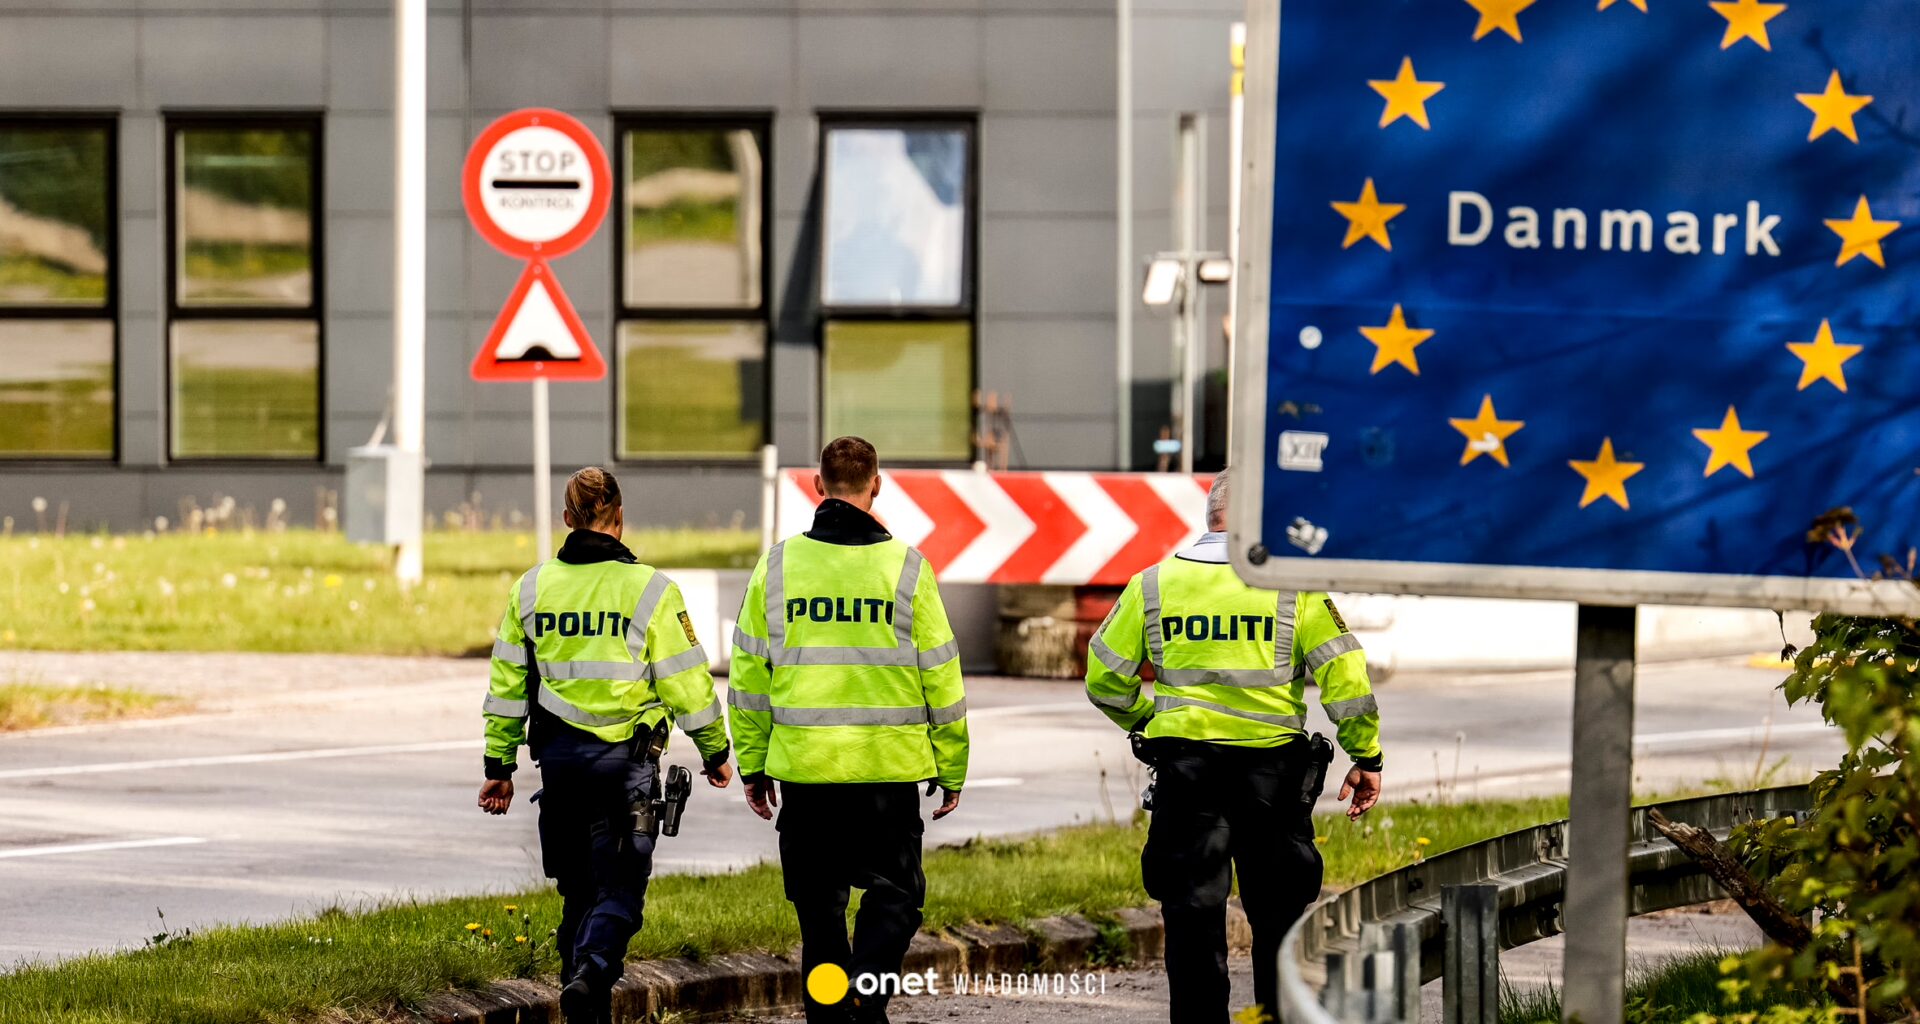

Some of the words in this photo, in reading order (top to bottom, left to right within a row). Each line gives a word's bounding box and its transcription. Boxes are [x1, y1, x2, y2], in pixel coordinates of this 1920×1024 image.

[499, 149, 576, 173] STOP
[1448, 190, 1781, 257] Danmark
[786, 596, 894, 625] POLITI
[1161, 614, 1274, 642] POLITI
